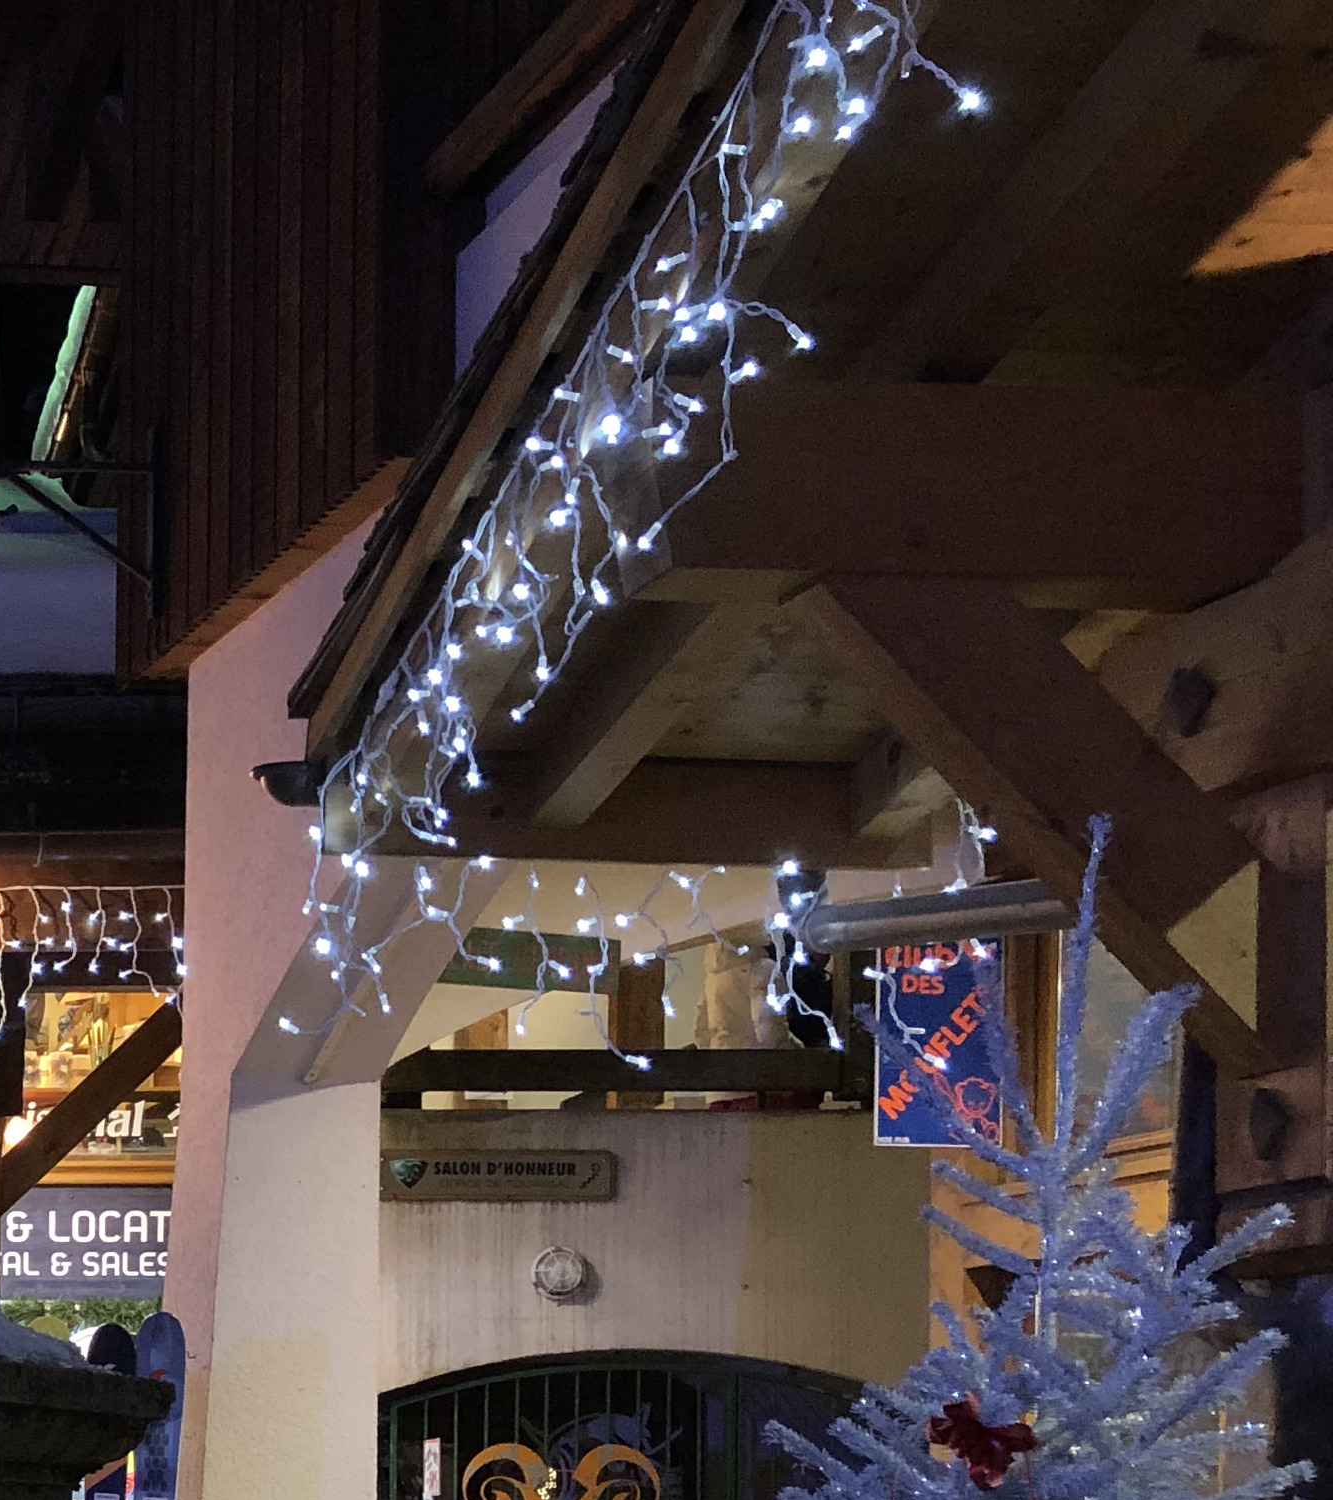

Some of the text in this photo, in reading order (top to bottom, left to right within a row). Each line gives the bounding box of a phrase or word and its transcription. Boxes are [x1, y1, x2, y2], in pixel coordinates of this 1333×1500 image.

[902, 974, 945, 995] DES
[434, 1162, 576, 1177] SALON D'HONNEUR
[6, 1210, 33, 1243] &
[49, 1210, 172, 1243] LOCAT
[51, 1252, 72, 1277] &
